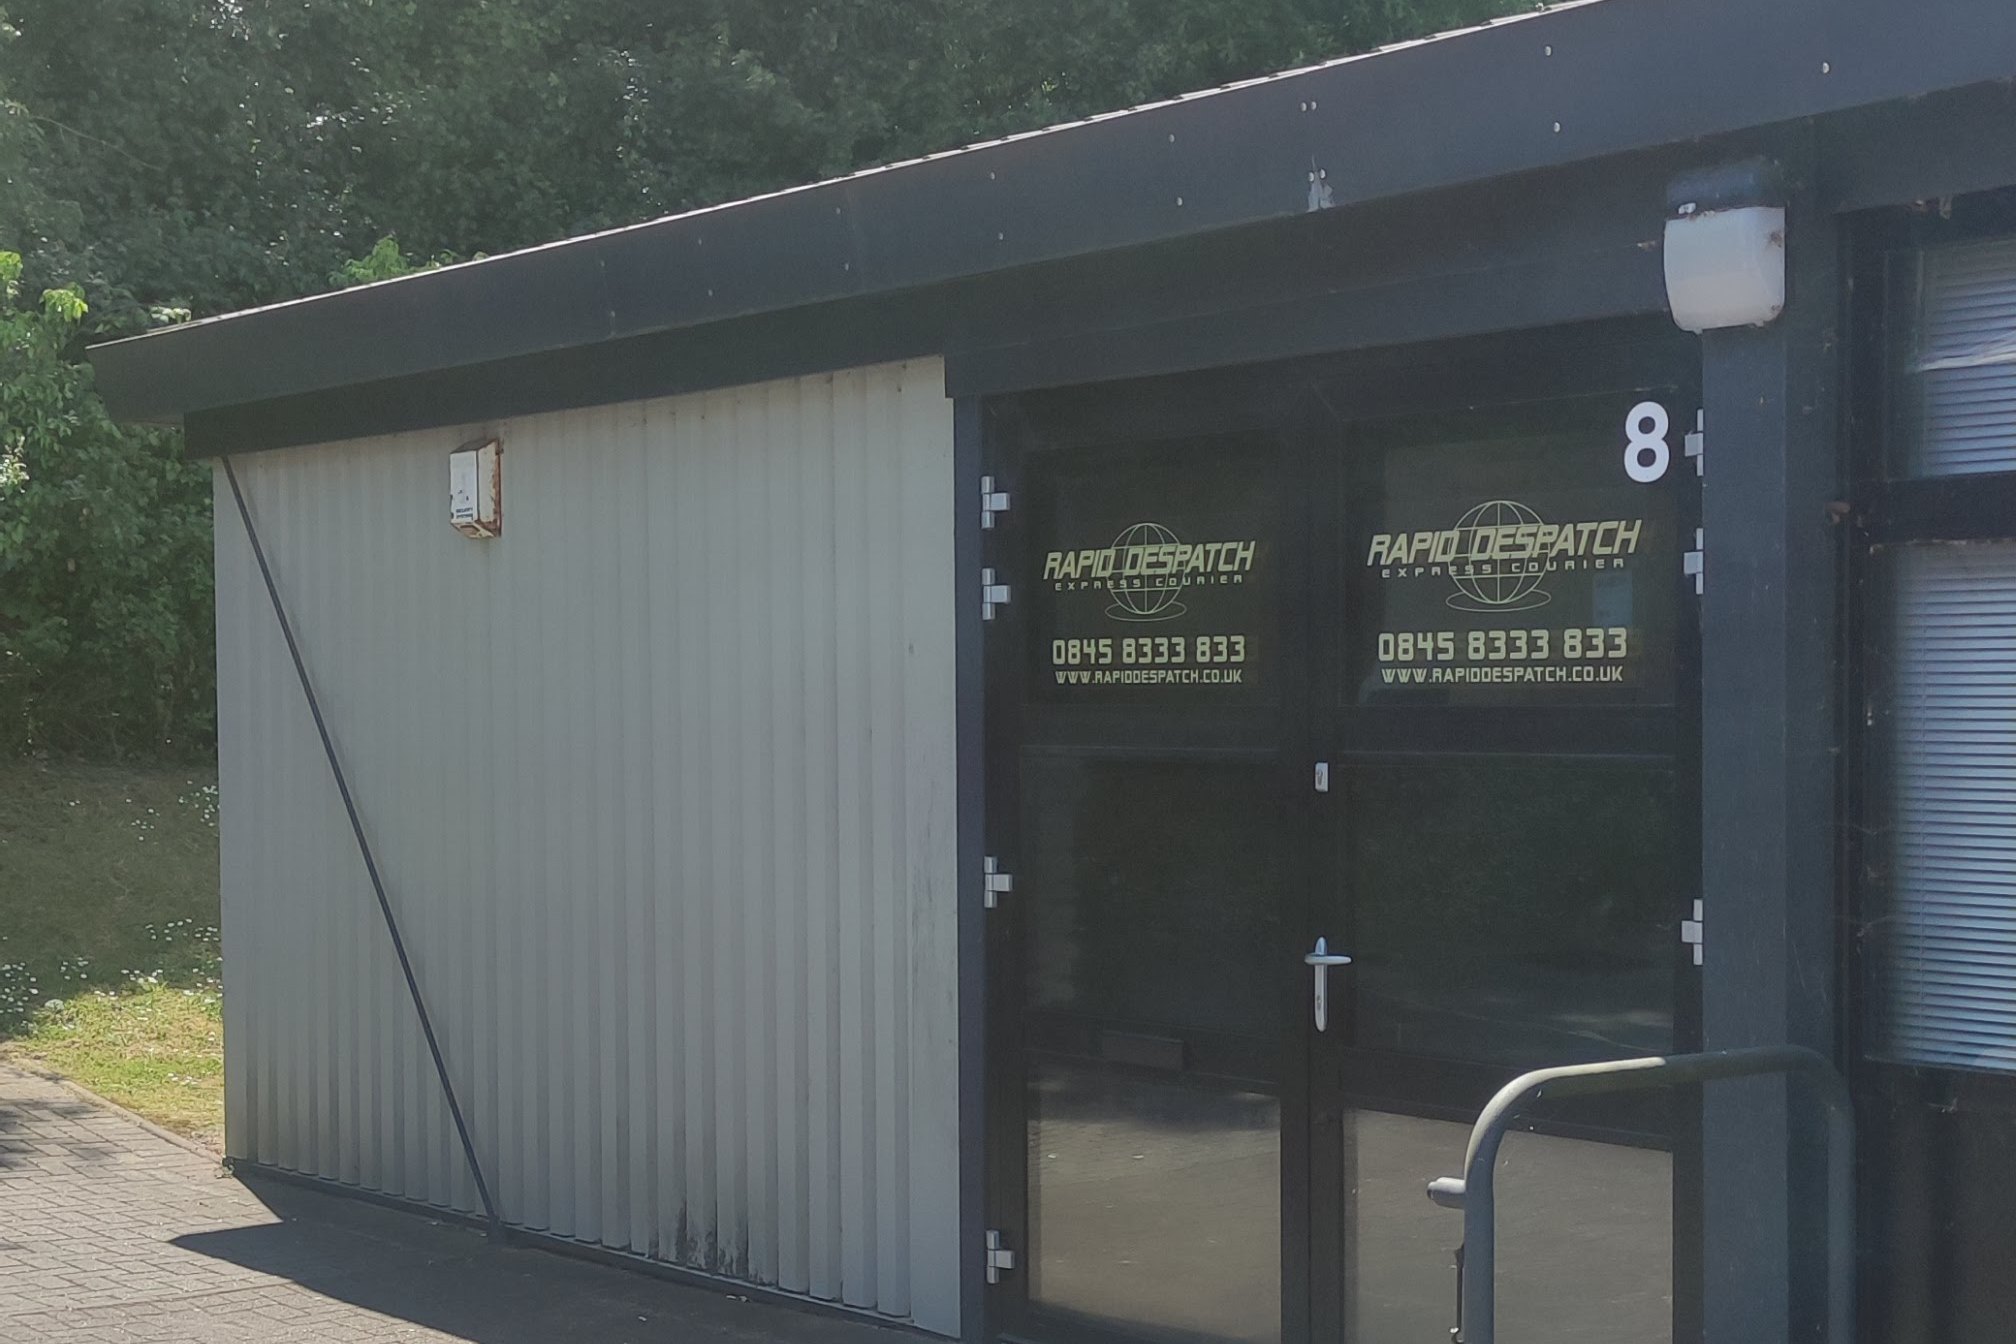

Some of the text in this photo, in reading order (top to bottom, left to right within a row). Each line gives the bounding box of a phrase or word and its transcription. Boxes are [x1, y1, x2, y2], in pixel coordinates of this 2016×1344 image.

[1624, 401, 1669, 482] 8
[1366, 519, 1643, 566] RAPID DESPATCH
[1043, 540, 1256, 579] RAPID DESPATCH
[1381, 558, 1625, 578] EXPRESS COURIER
[1054, 574, 1243, 591] EXPRESS COURIER
[1052, 635, 1245, 665] 0845 8333 833
[1377, 627, 1628, 662] 0845 8333 833
[1055, 669, 1243, 684] WWW.RAPIDDESPATCH.CO.UK
[1381, 665, 1624, 684] WWW.RAPIDDESPATCH.CO.UK
